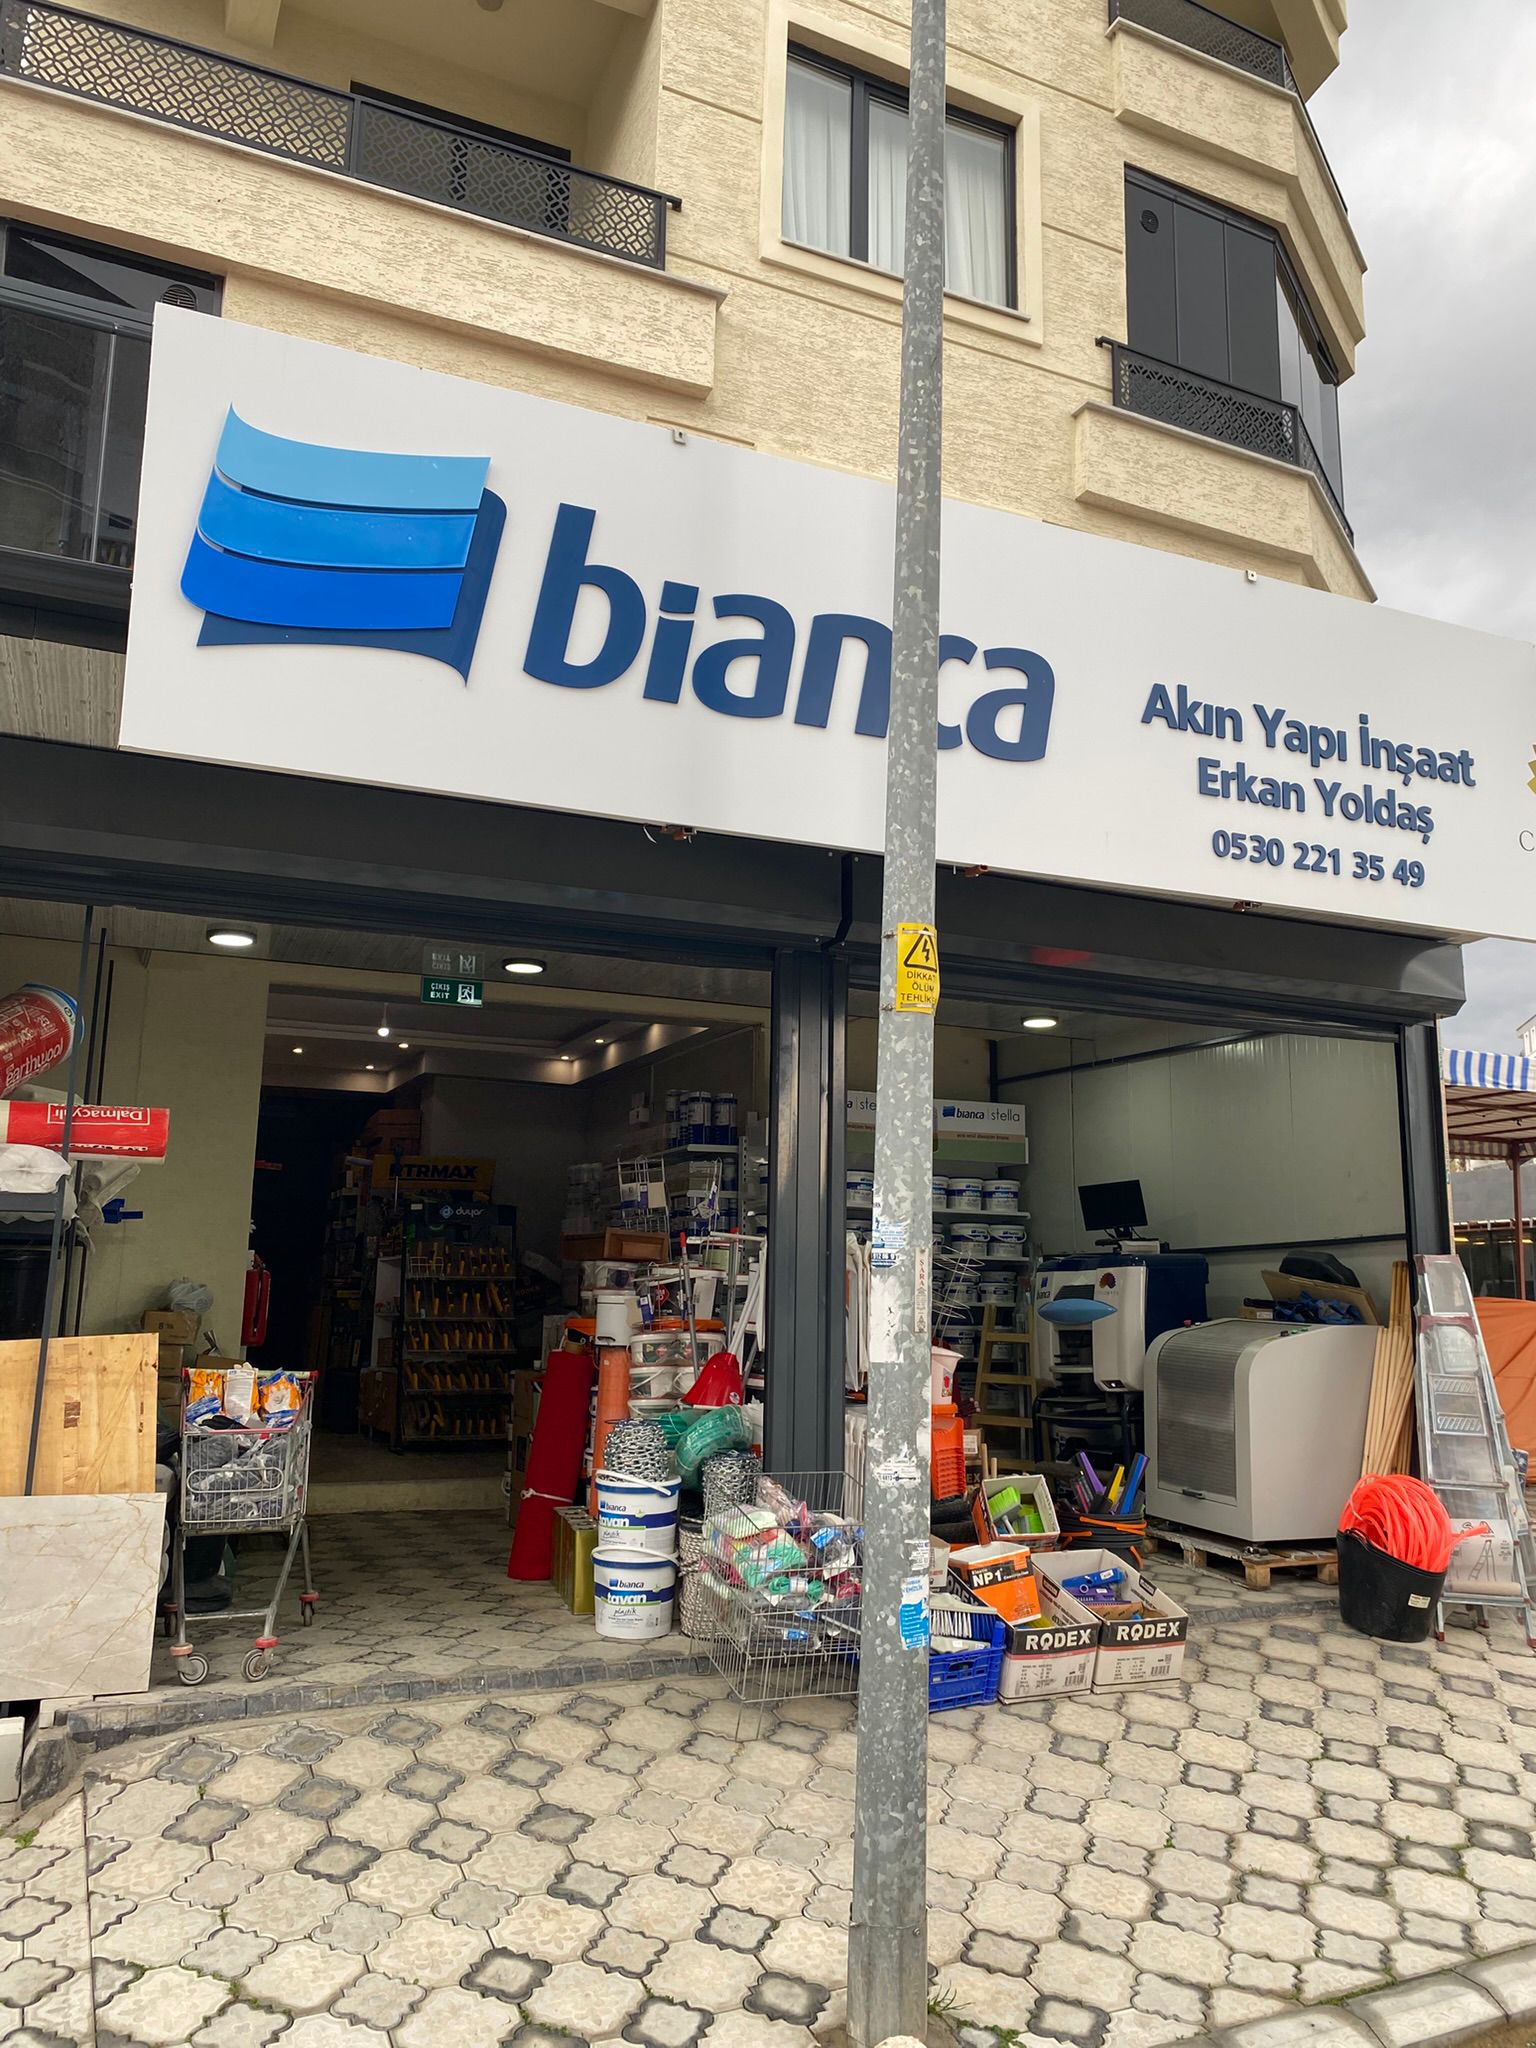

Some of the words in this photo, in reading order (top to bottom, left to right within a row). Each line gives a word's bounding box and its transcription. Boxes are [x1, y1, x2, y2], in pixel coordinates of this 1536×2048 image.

[1141, 683, 1243, 742] Akın
[1253, 703, 1347, 768] Yapı
[1359, 713, 1477, 787] İnşaat
[1198, 757, 1306, 812] Erkan
[1314, 778, 1435, 844] Yoldaş
[1212, 829, 1285, 866] 0530
[1293, 841, 1341, 875] 221
[1352, 851, 1385, 881] 35
[1393, 858, 1425, 888] 49
[430, 991, 450, 999] EXIT
[6, 1037, 64, 1088] earthwool
[54, 1106, 143, 1121] Dalmacylı
[991, 1108, 1020, 1122] stella
[618, 1579, 645, 1589] bianca
[607, 1591, 647, 1605] tavan
[1025, 1628, 1092, 1651] RODEX
[1117, 1622, 1181, 1642] RODEX
